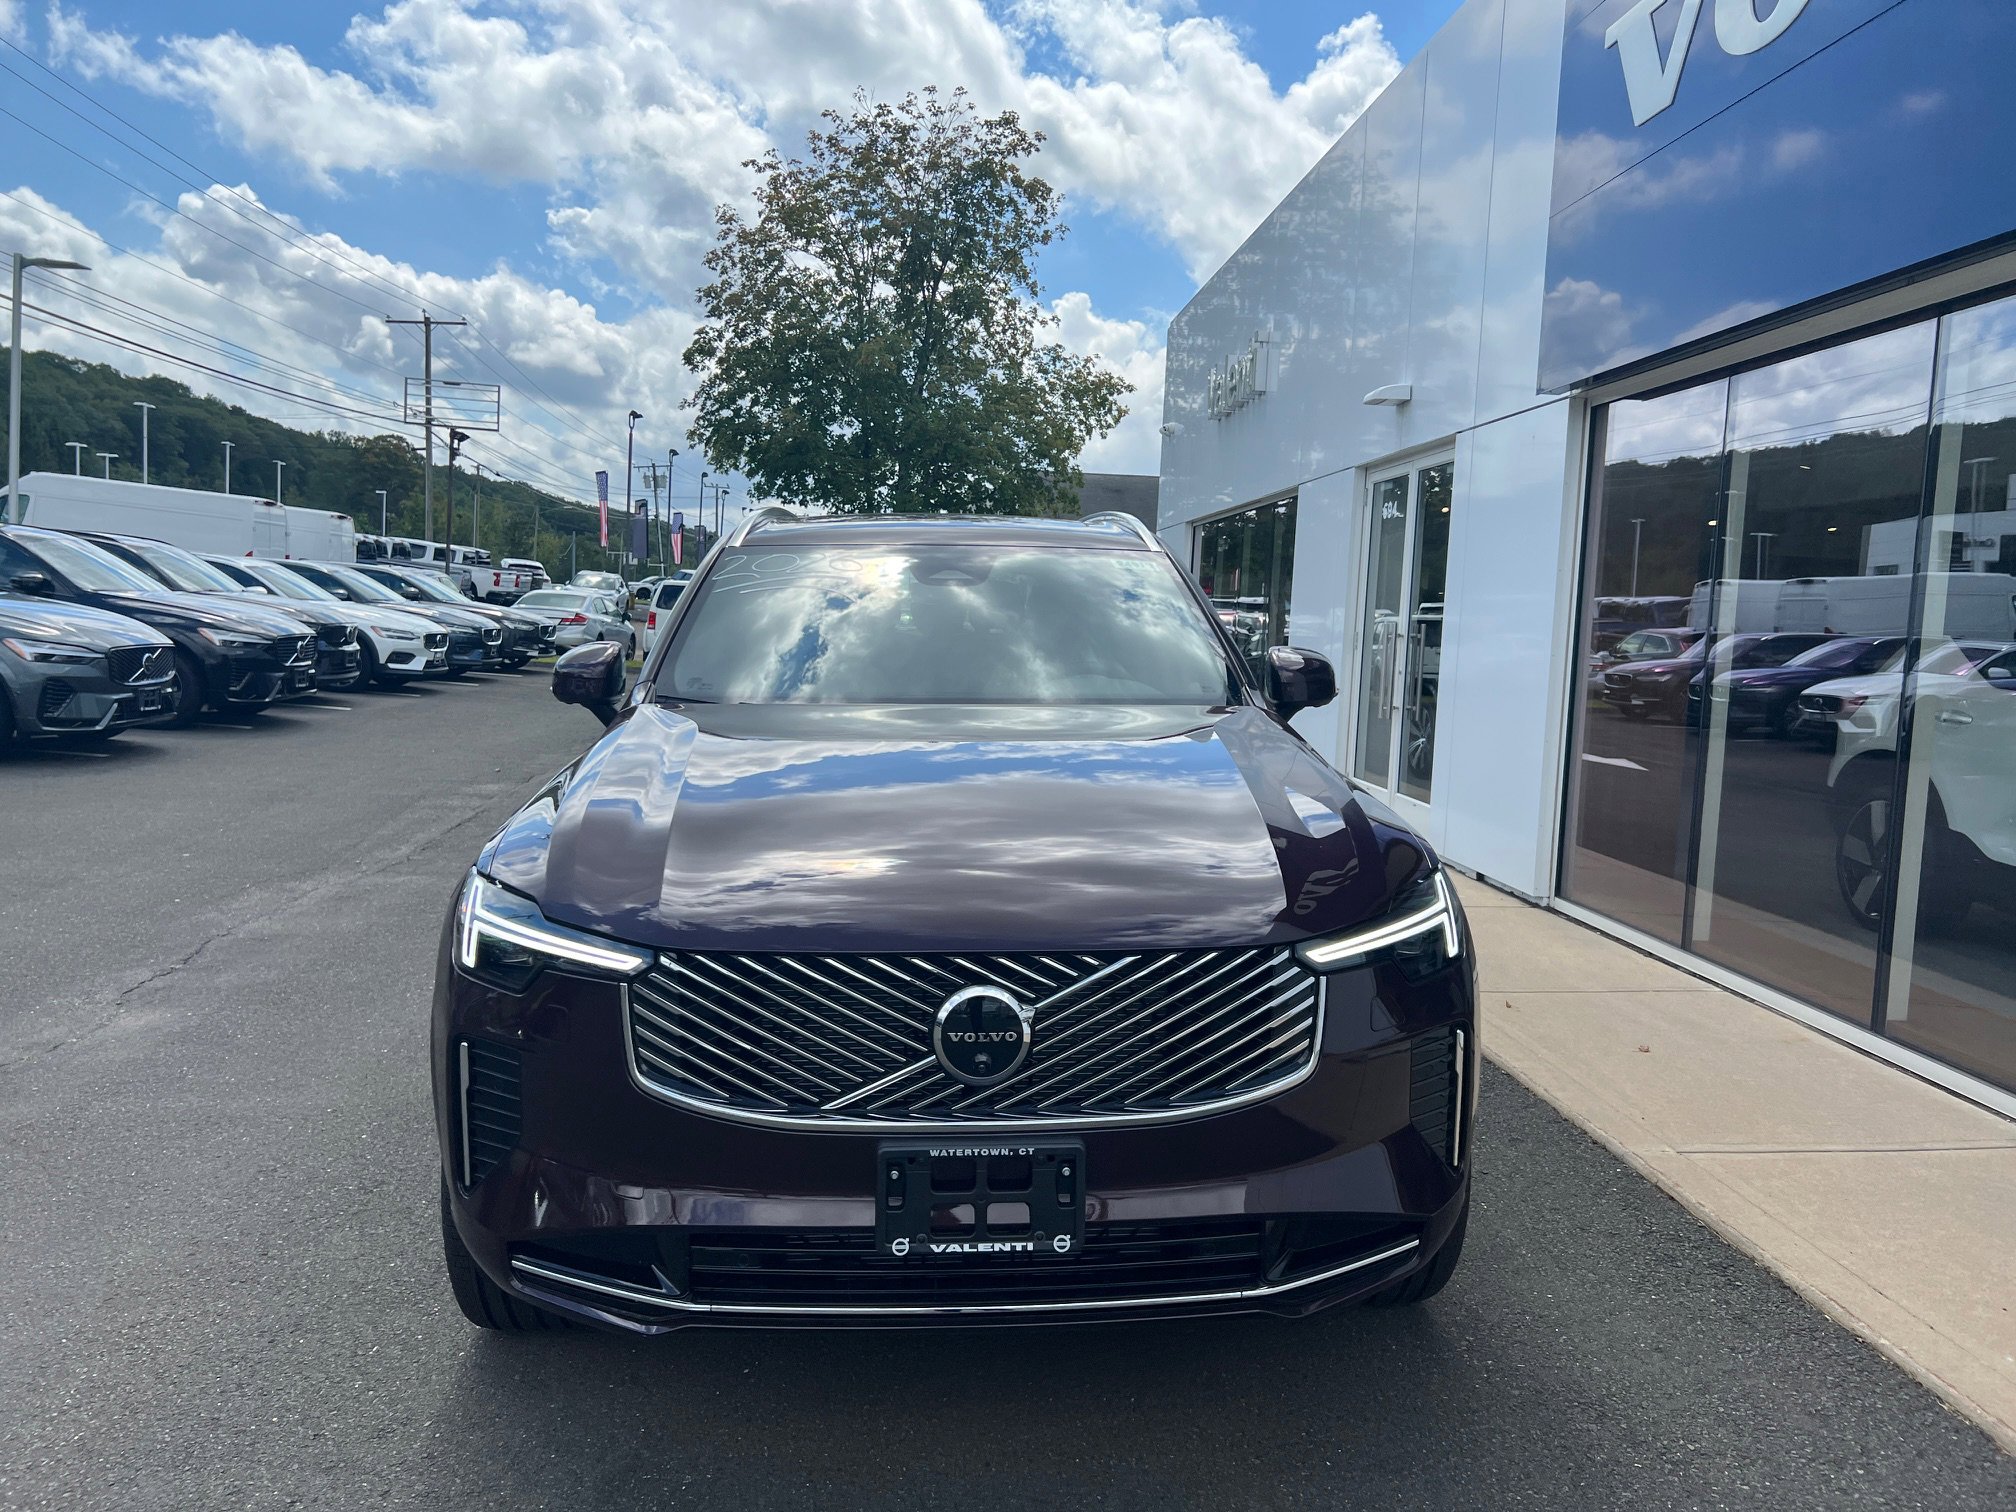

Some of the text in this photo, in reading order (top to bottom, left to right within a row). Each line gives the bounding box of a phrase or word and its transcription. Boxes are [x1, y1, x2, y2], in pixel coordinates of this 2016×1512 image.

[947, 1031, 1018, 1042] VOLVO
[929, 1148, 1035, 1157] WATERTOWN, CT
[930, 1243, 1034, 1253] VALENTI
